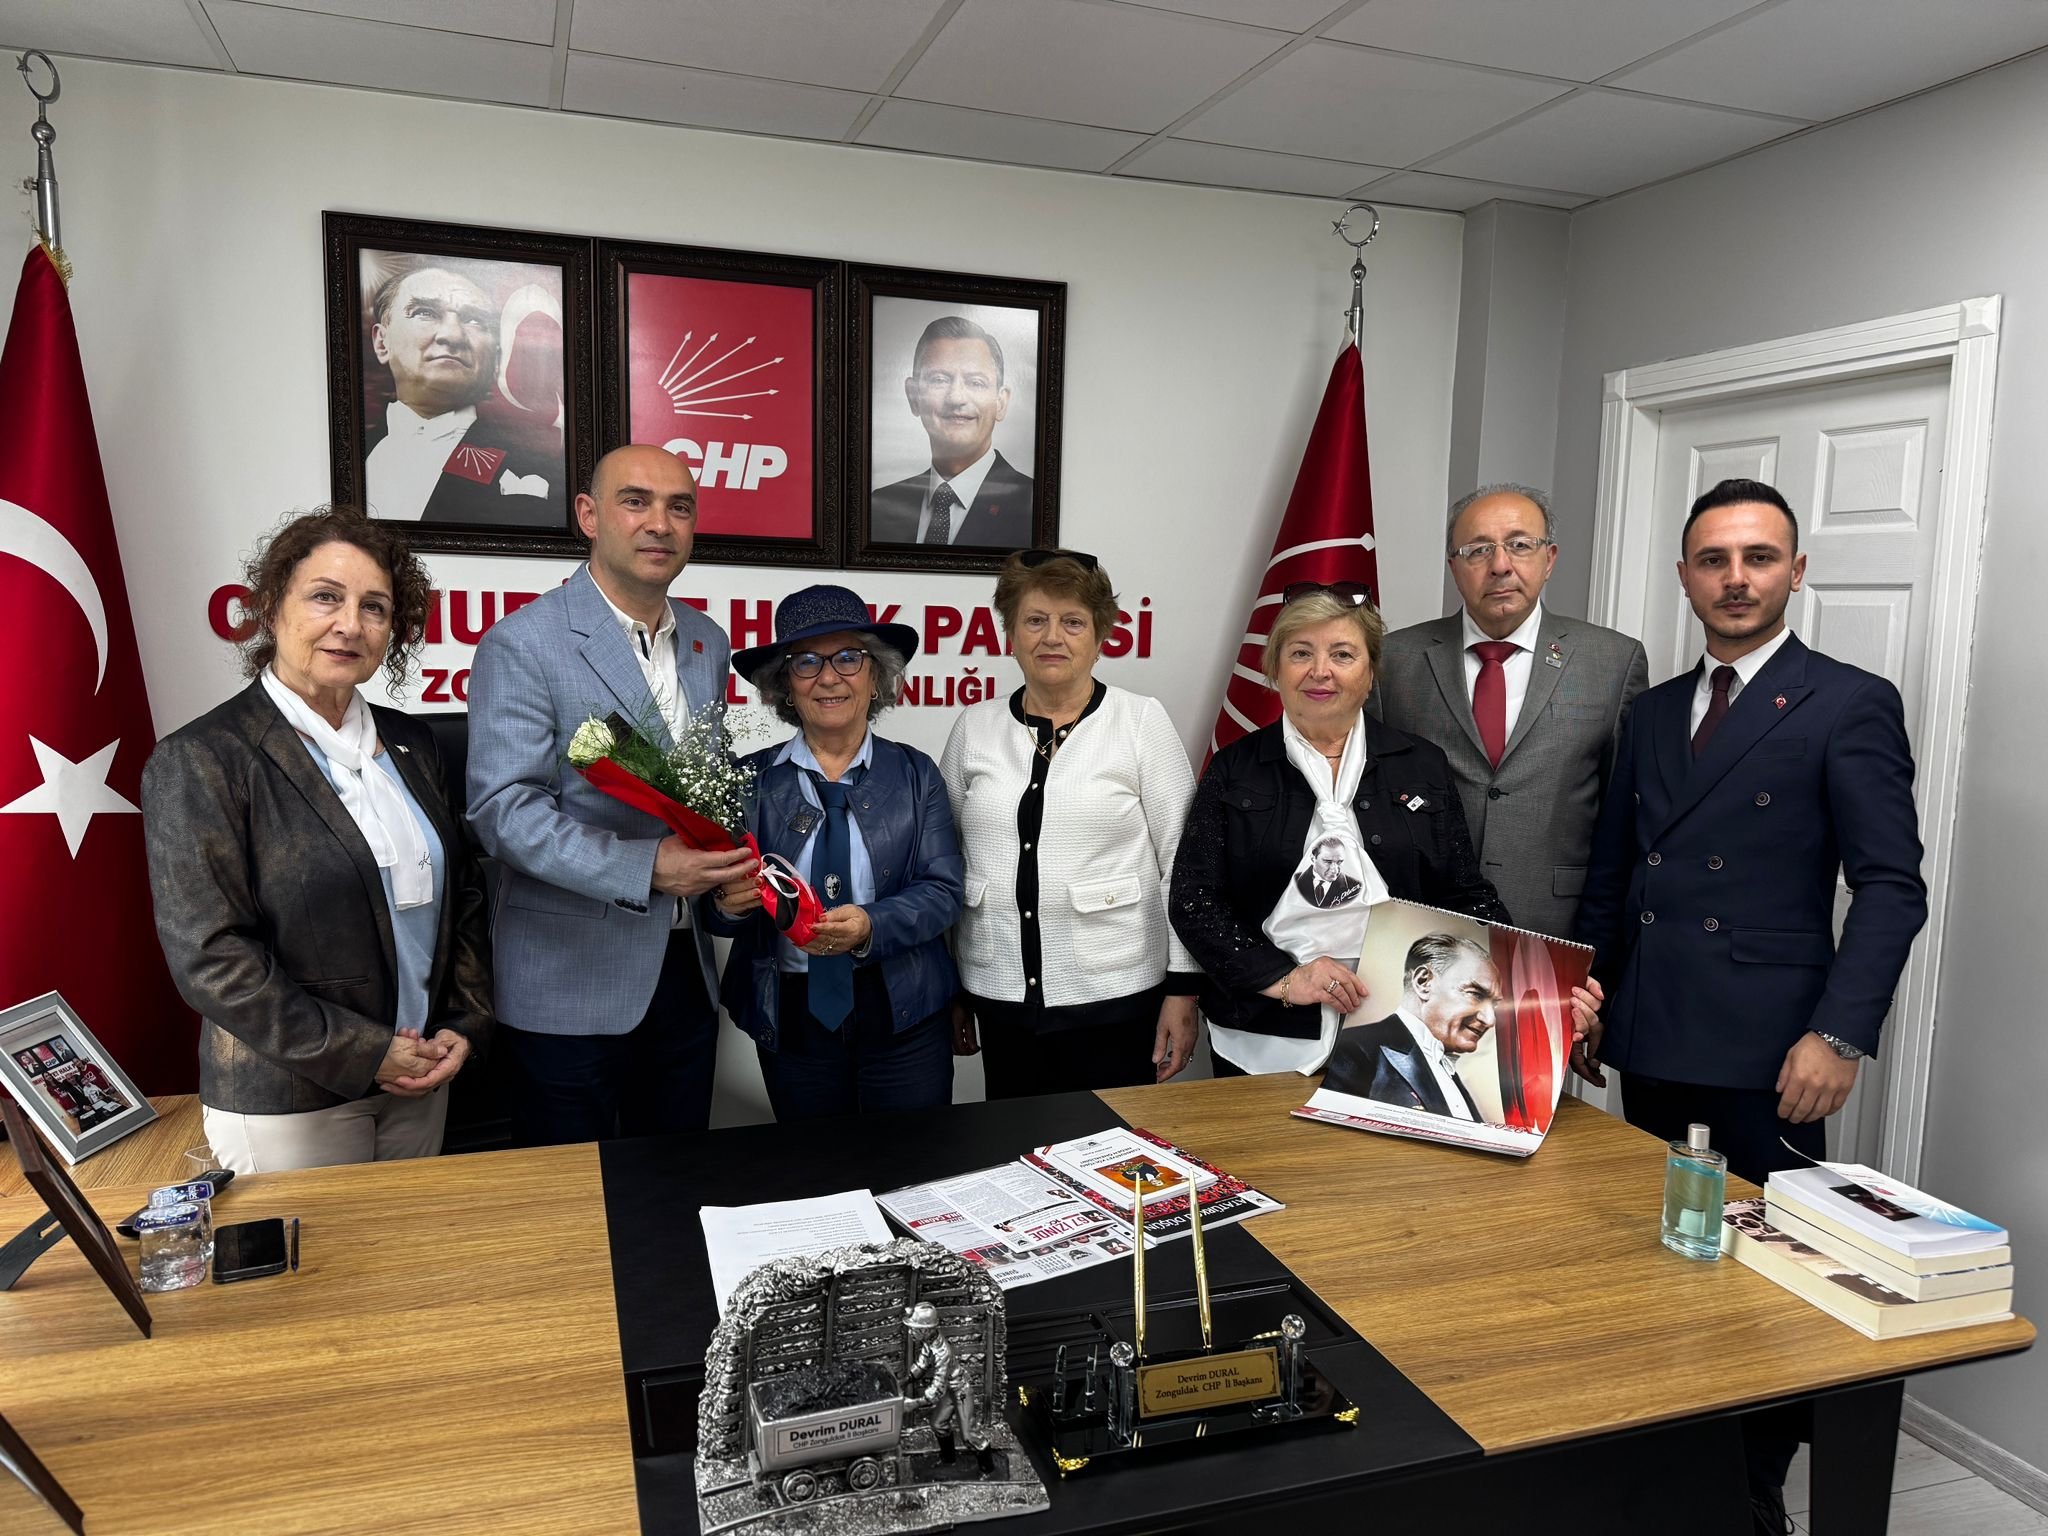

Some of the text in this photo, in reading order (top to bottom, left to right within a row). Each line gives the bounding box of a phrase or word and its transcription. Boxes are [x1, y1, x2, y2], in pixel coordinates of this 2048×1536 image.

[661, 438, 788, 491] CHP
[923, 596, 1153, 659] PASİ
[1155, 1385, 1199, 1400] Zonguldak
[1202, 1381, 1221, 1392] CHP
[1233, 1375, 1263, 1388] Başkanı
[1177, 1367, 1239, 1384] Devrim DURAL
[790, 1414, 882, 1442] Devrim DURAL
